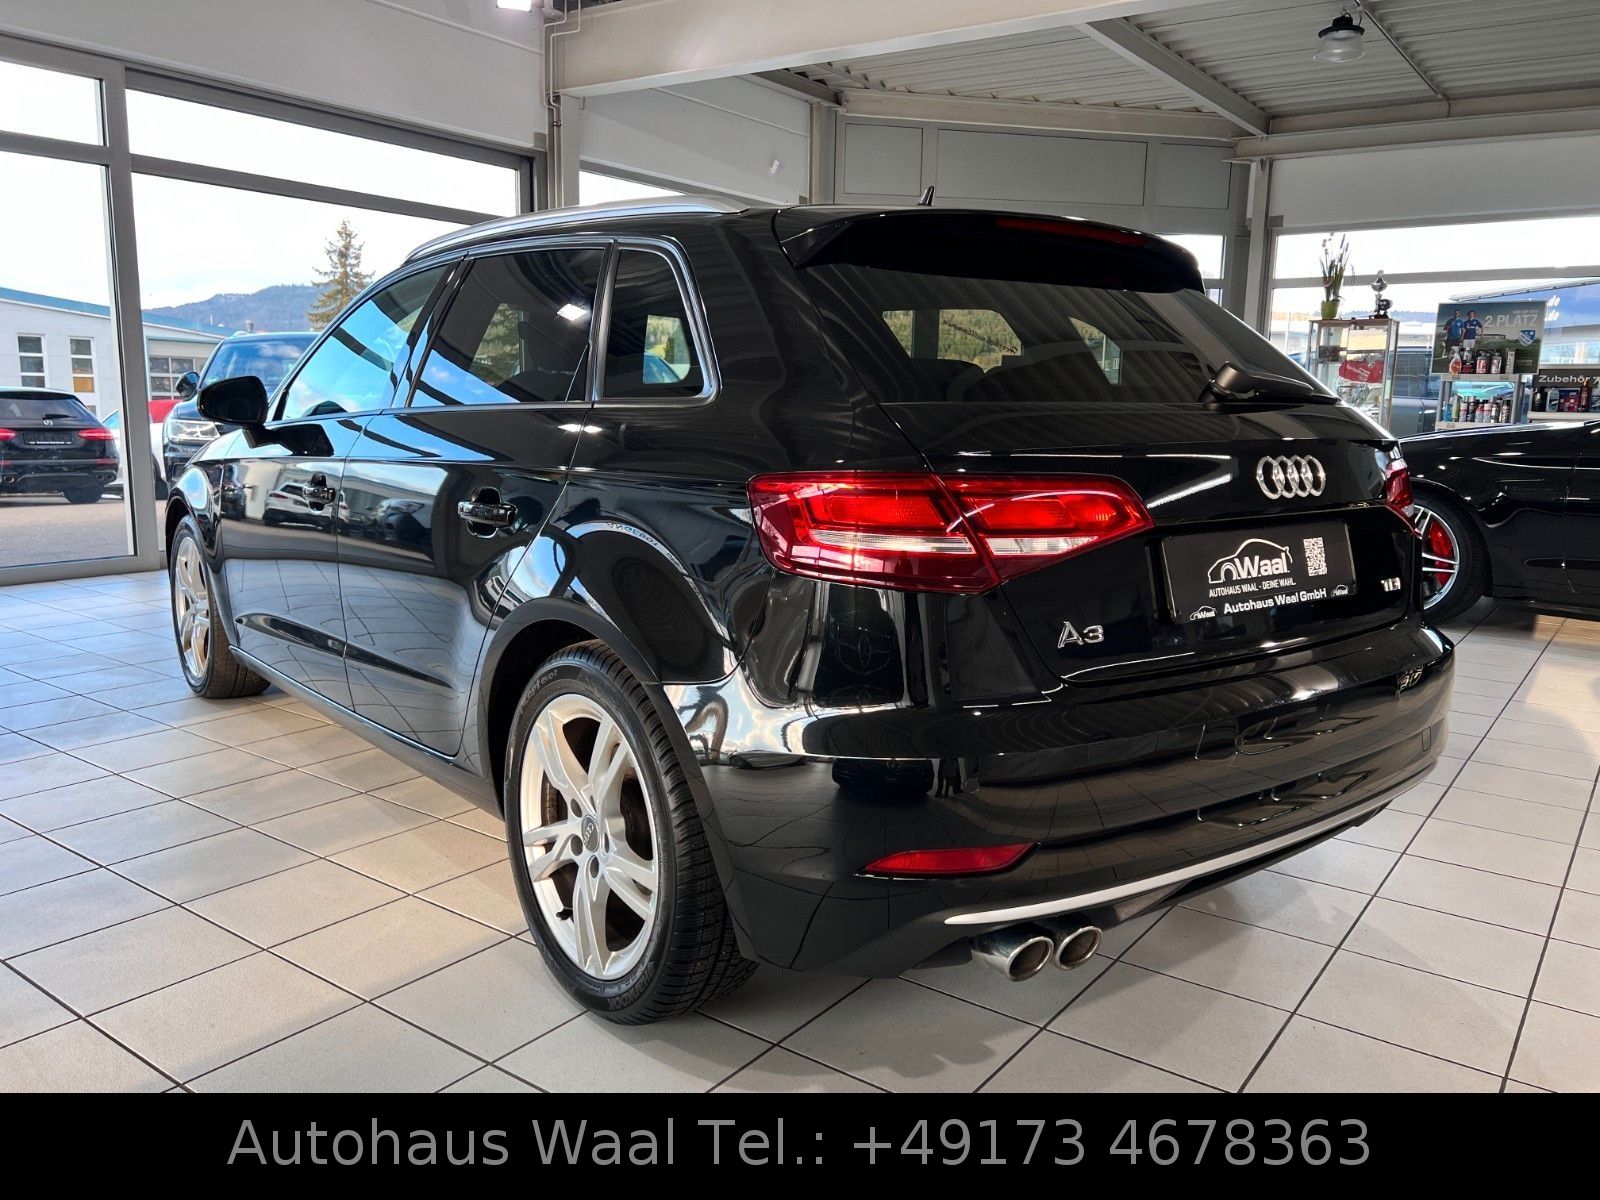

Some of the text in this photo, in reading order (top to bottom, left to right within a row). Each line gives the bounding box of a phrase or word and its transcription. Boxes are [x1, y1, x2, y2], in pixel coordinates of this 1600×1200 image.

[1496, 314, 1538, 328] PLATZ
[1538, 374, 1591, 383] Zubehör
[1234, 552, 1290, 580] Waal
[1209, 585, 1241, 598] AUTOHAUS
[1241, 582, 1259, 593] WAAL
[1262, 579, 1279, 590] DEINE
[1223, 587, 1327, 615] Autohaus Waal GmbH
[1057, 621, 1104, 649] A3
